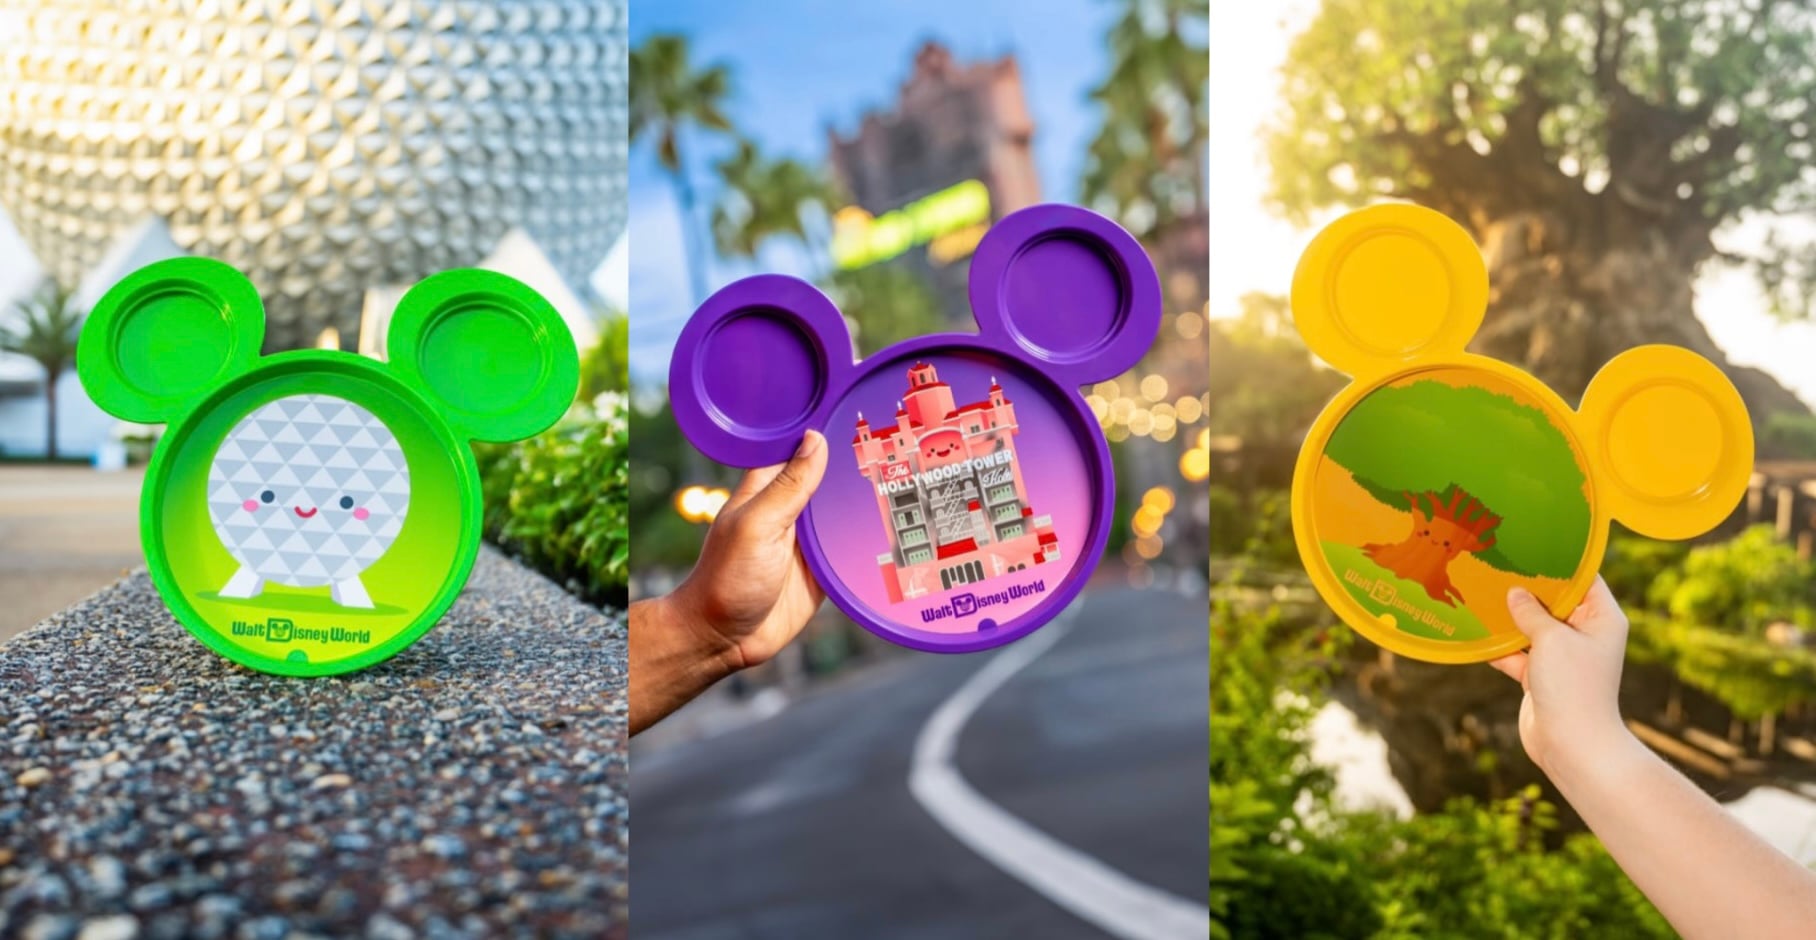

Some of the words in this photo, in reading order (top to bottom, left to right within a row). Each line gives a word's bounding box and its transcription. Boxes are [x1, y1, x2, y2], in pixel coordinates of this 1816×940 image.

[878, 462, 961, 495] HOLLYWOOD
[962, 449, 1013, 473] TOWER
[887, 463, 910, 480] The
[920, 605, 953, 622] Walt
[950, 591, 1010, 619] Disney
[1007, 580, 1045, 600] World
[1344, 568, 1375, 593] Walt
[1368, 579, 1421, 621] Disney
[1420, 610, 1456, 637] World
[231, 621, 265, 637] Walt
[265, 618, 329, 644] Disney
[329, 627, 371, 644] World
